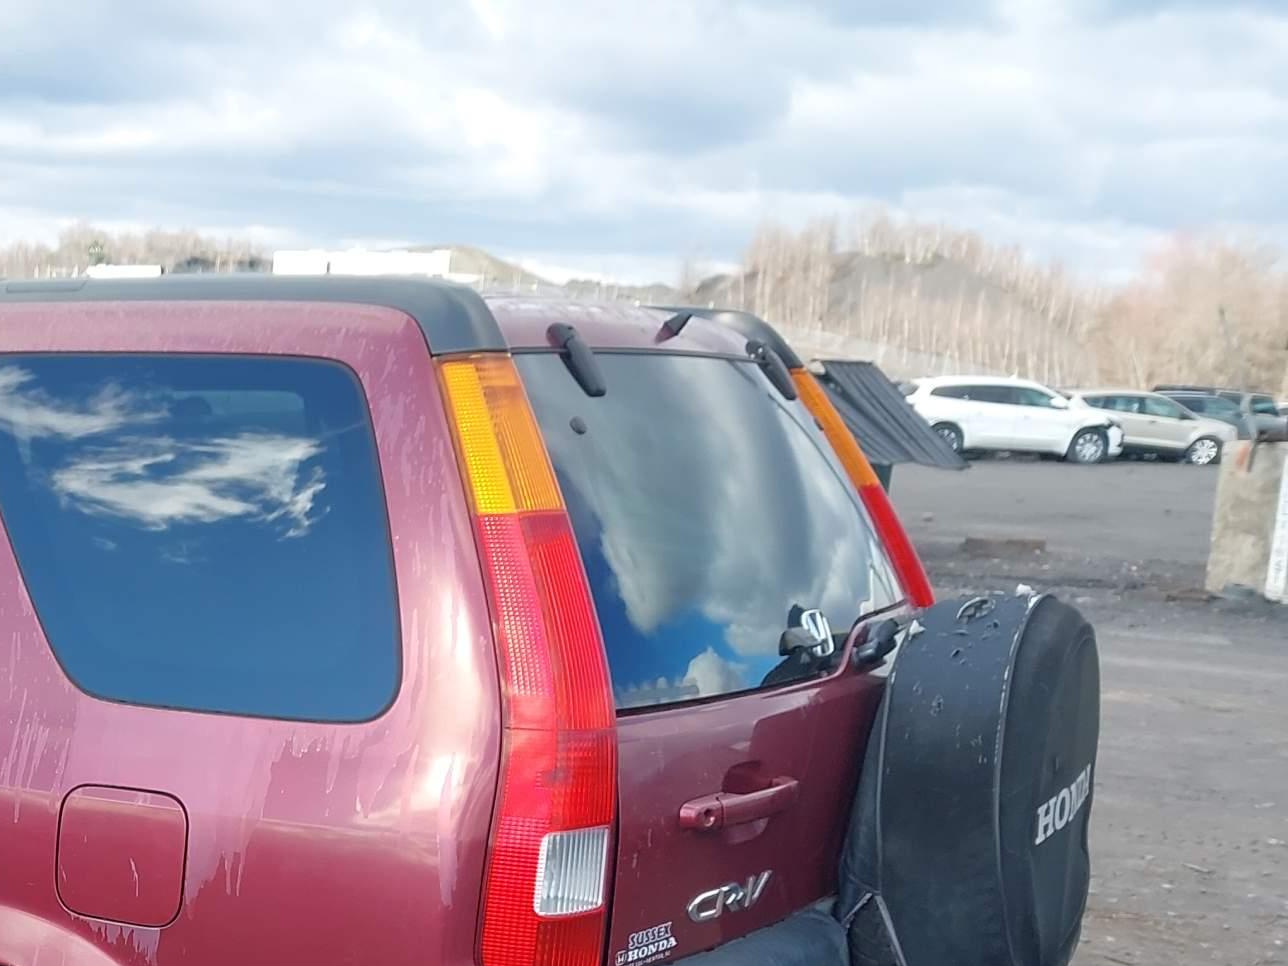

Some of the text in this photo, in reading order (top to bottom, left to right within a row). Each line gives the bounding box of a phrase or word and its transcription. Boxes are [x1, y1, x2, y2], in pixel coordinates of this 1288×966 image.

[686, 869, 774, 923] CR-V
[627, 936, 678, 962] HONDA
[628, 921, 673, 949] SUSSEX
